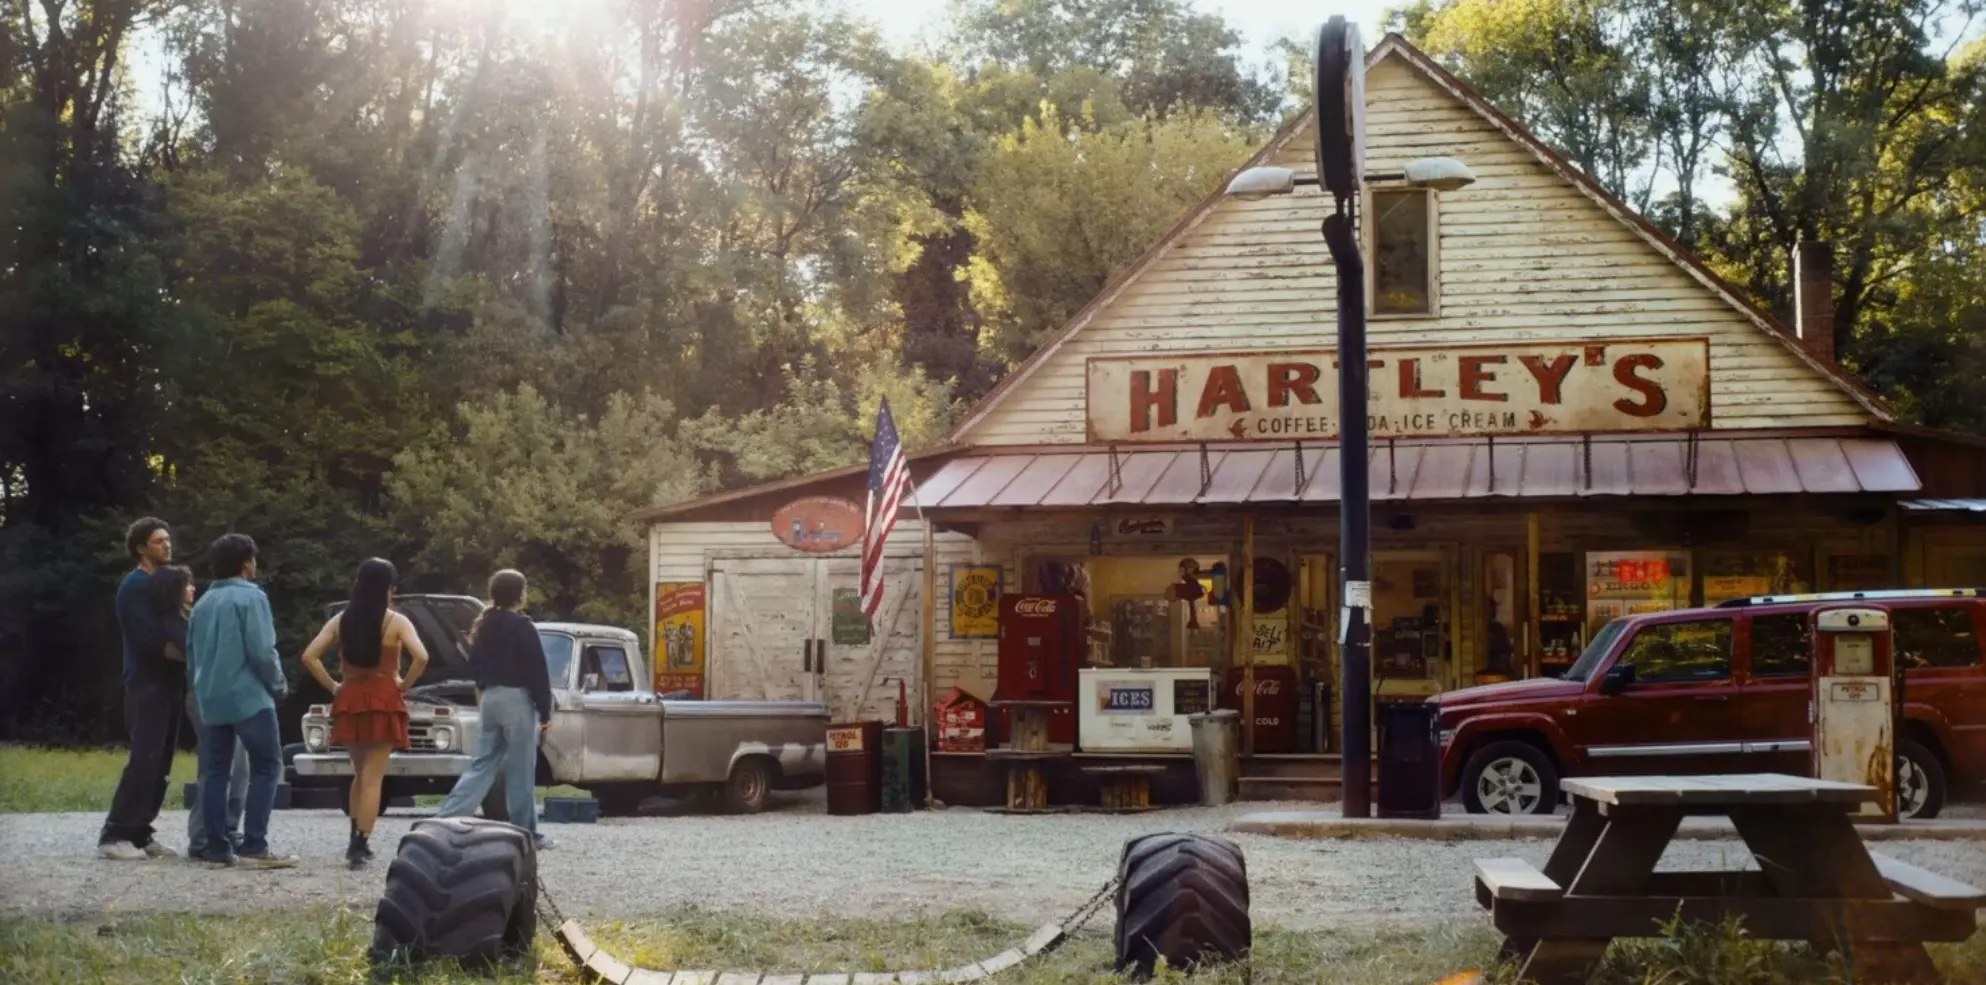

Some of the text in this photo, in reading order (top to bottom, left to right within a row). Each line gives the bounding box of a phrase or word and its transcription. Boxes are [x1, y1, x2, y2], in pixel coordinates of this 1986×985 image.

[1257, 411, 1516, 433] COFFEE DA ICE CREAM
[1111, 691, 1151, 706] ICES
[1255, 717, 1279, 726] COLD
